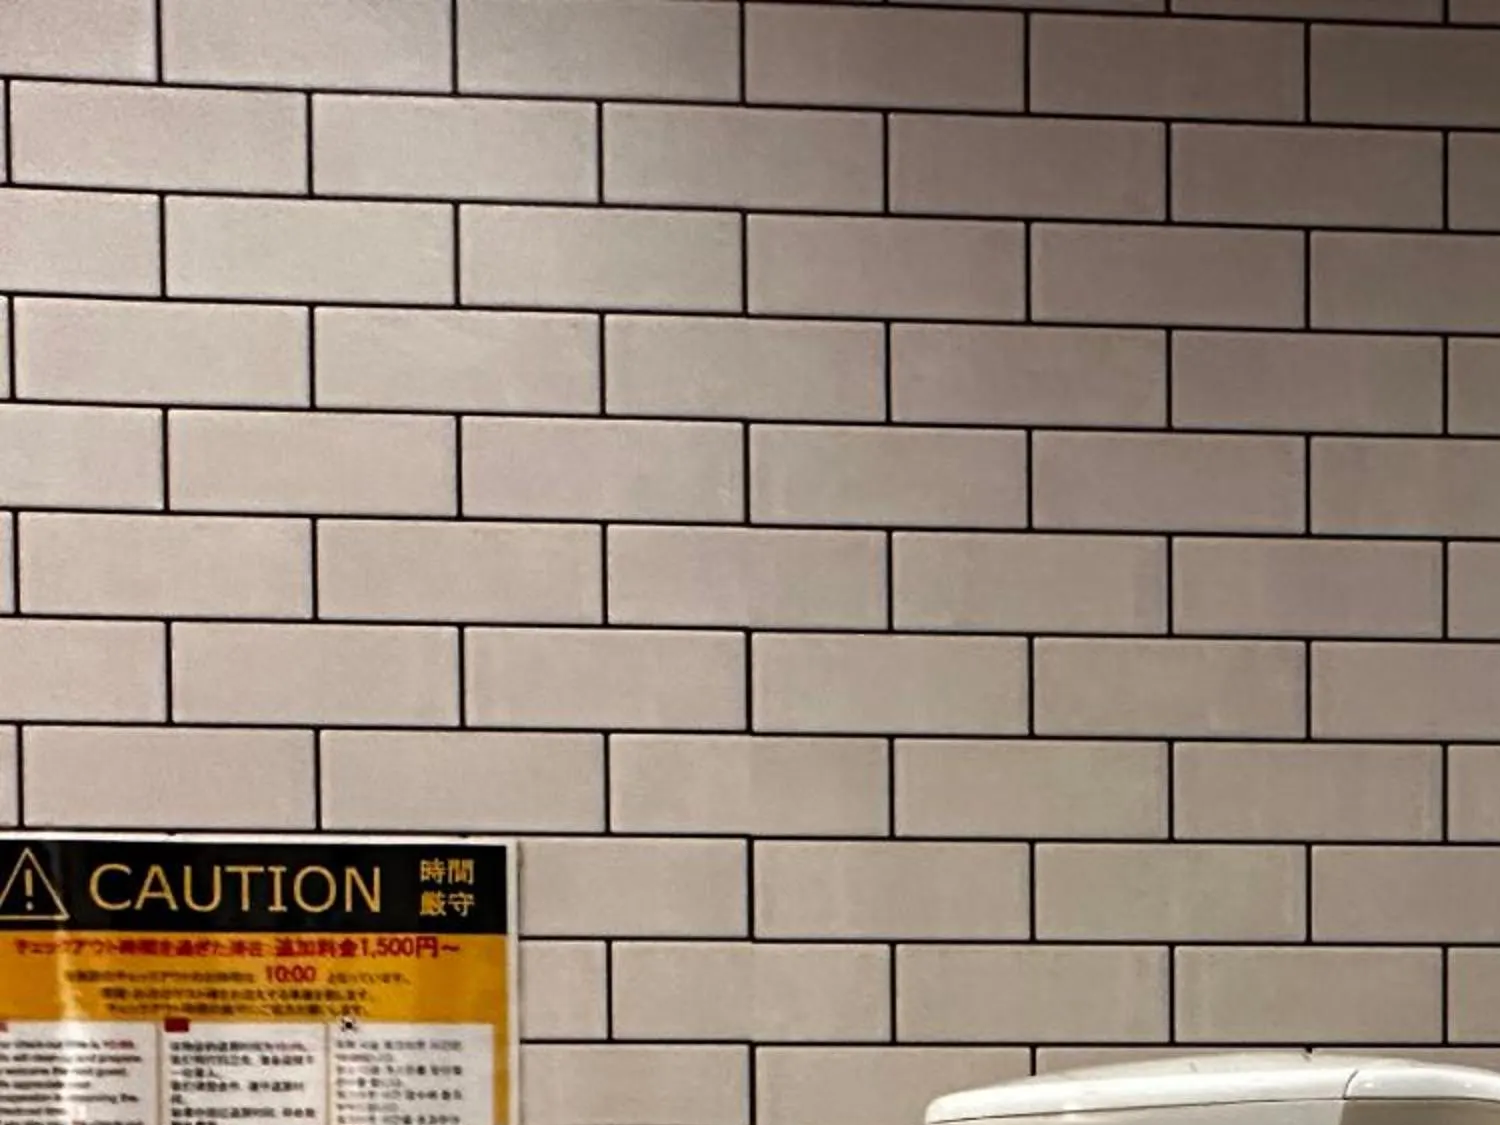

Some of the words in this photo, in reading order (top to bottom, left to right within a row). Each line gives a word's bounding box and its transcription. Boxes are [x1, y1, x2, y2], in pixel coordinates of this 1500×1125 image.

[420, 858, 475, 884] 時間
[89, 864, 382, 914] CAUTION
[265, 965, 317, 984] 10:00
